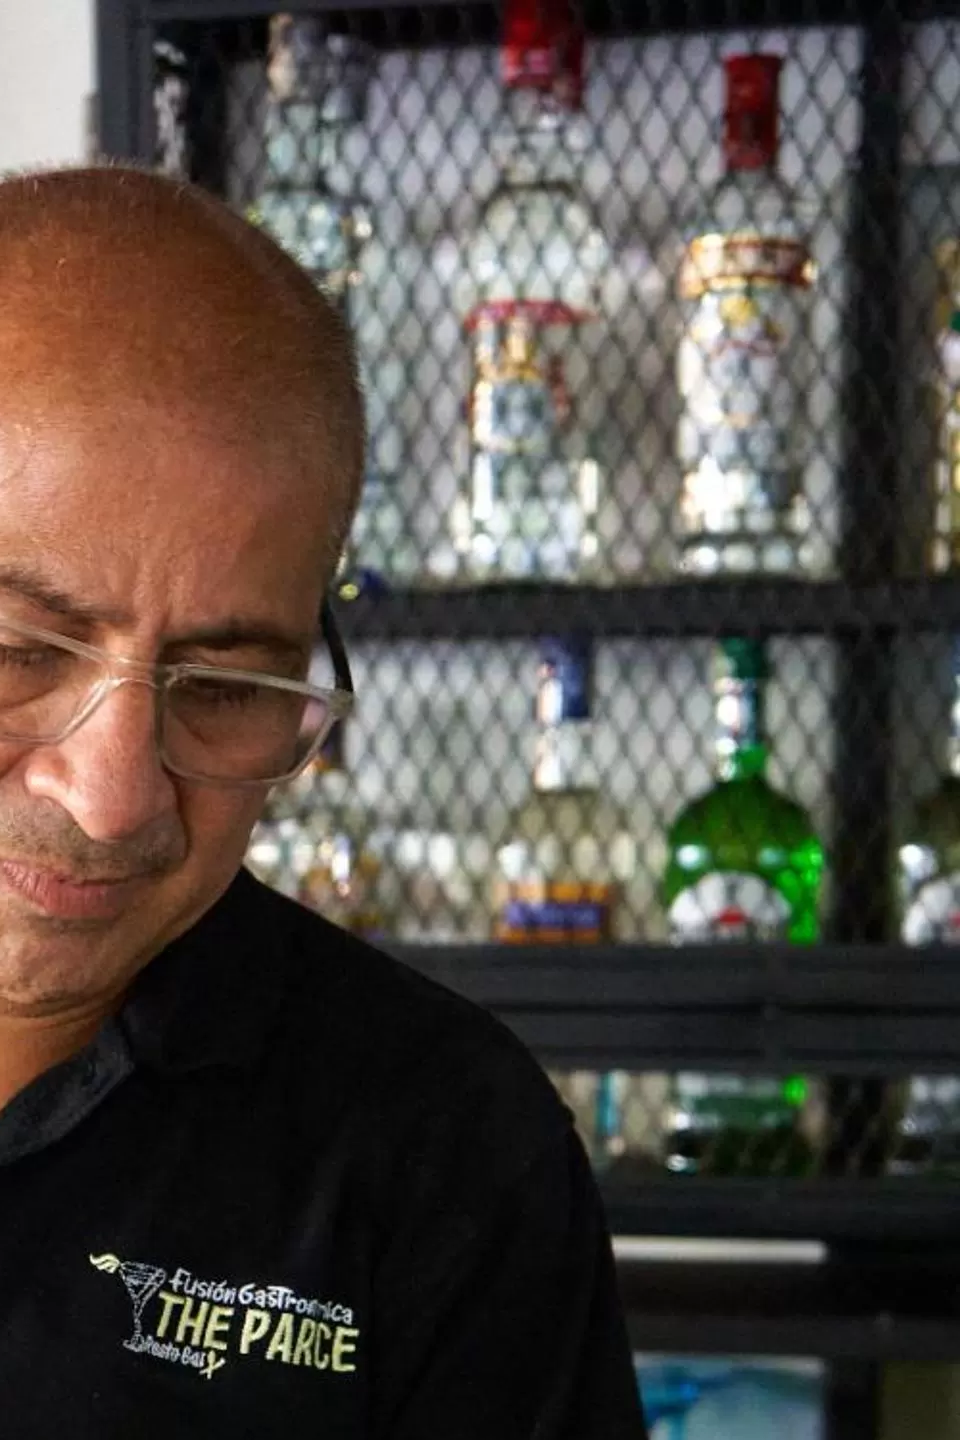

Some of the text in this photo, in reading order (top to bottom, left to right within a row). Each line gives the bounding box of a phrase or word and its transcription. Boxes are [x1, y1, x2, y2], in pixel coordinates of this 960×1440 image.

[169, 1267, 236, 1305] Fusión
[158, 1290, 360, 1373] THE PARCE
